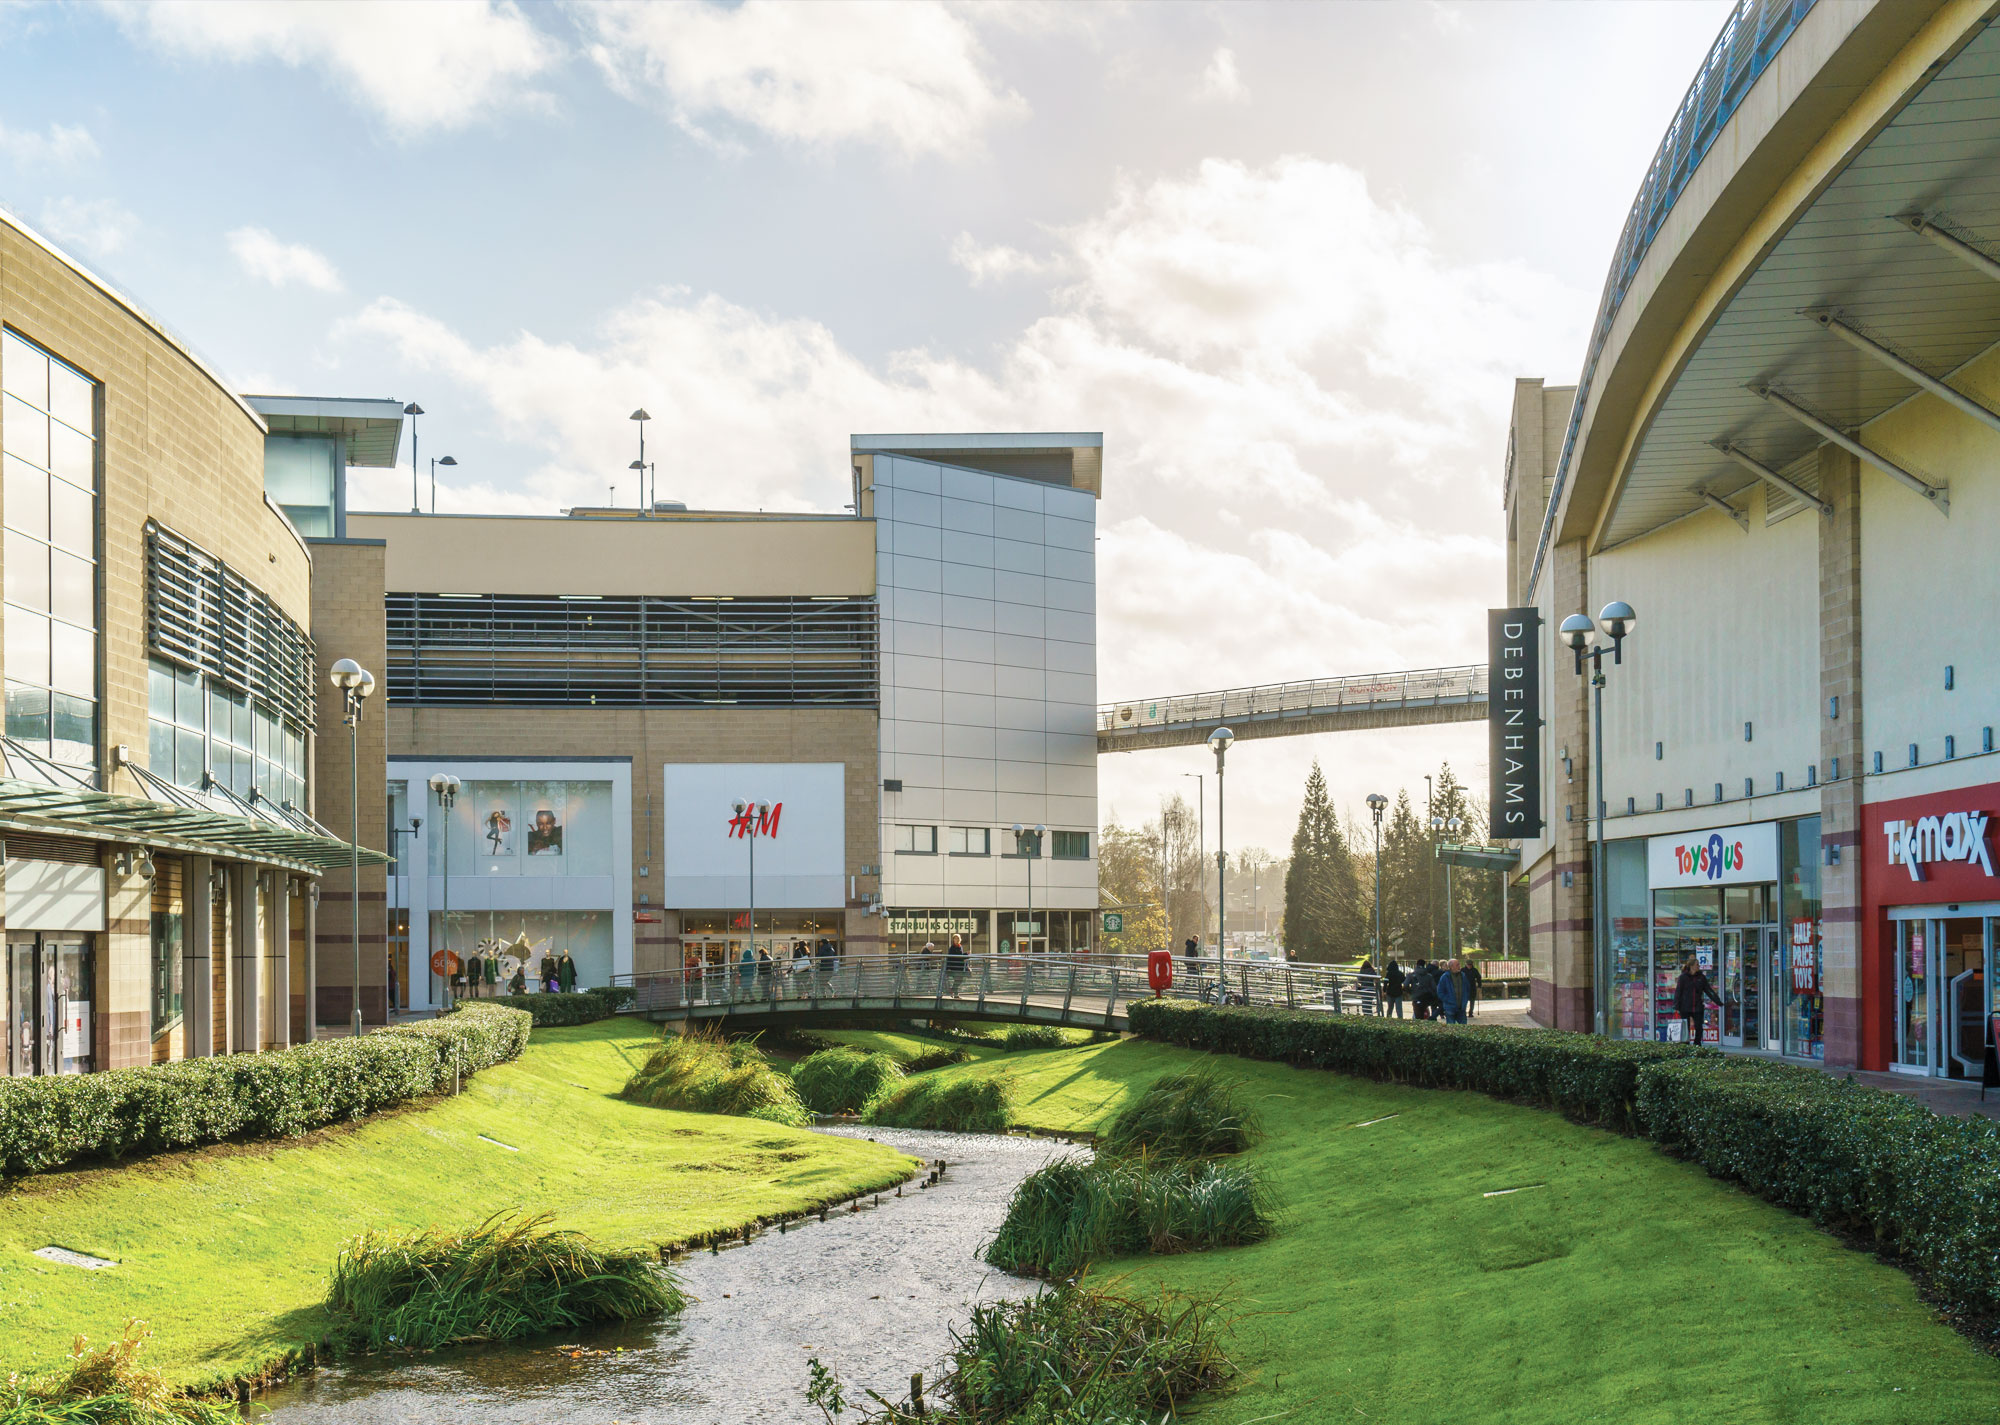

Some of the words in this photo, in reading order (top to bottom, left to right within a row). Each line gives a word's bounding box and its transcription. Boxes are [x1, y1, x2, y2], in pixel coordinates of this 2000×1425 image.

[1504, 623, 1525, 823] DEBENHAMS
[1794, 921, 1811, 944] HALF
[1792, 944, 1814, 967] PRICE
[1794, 967, 1813, 989] TOYS
